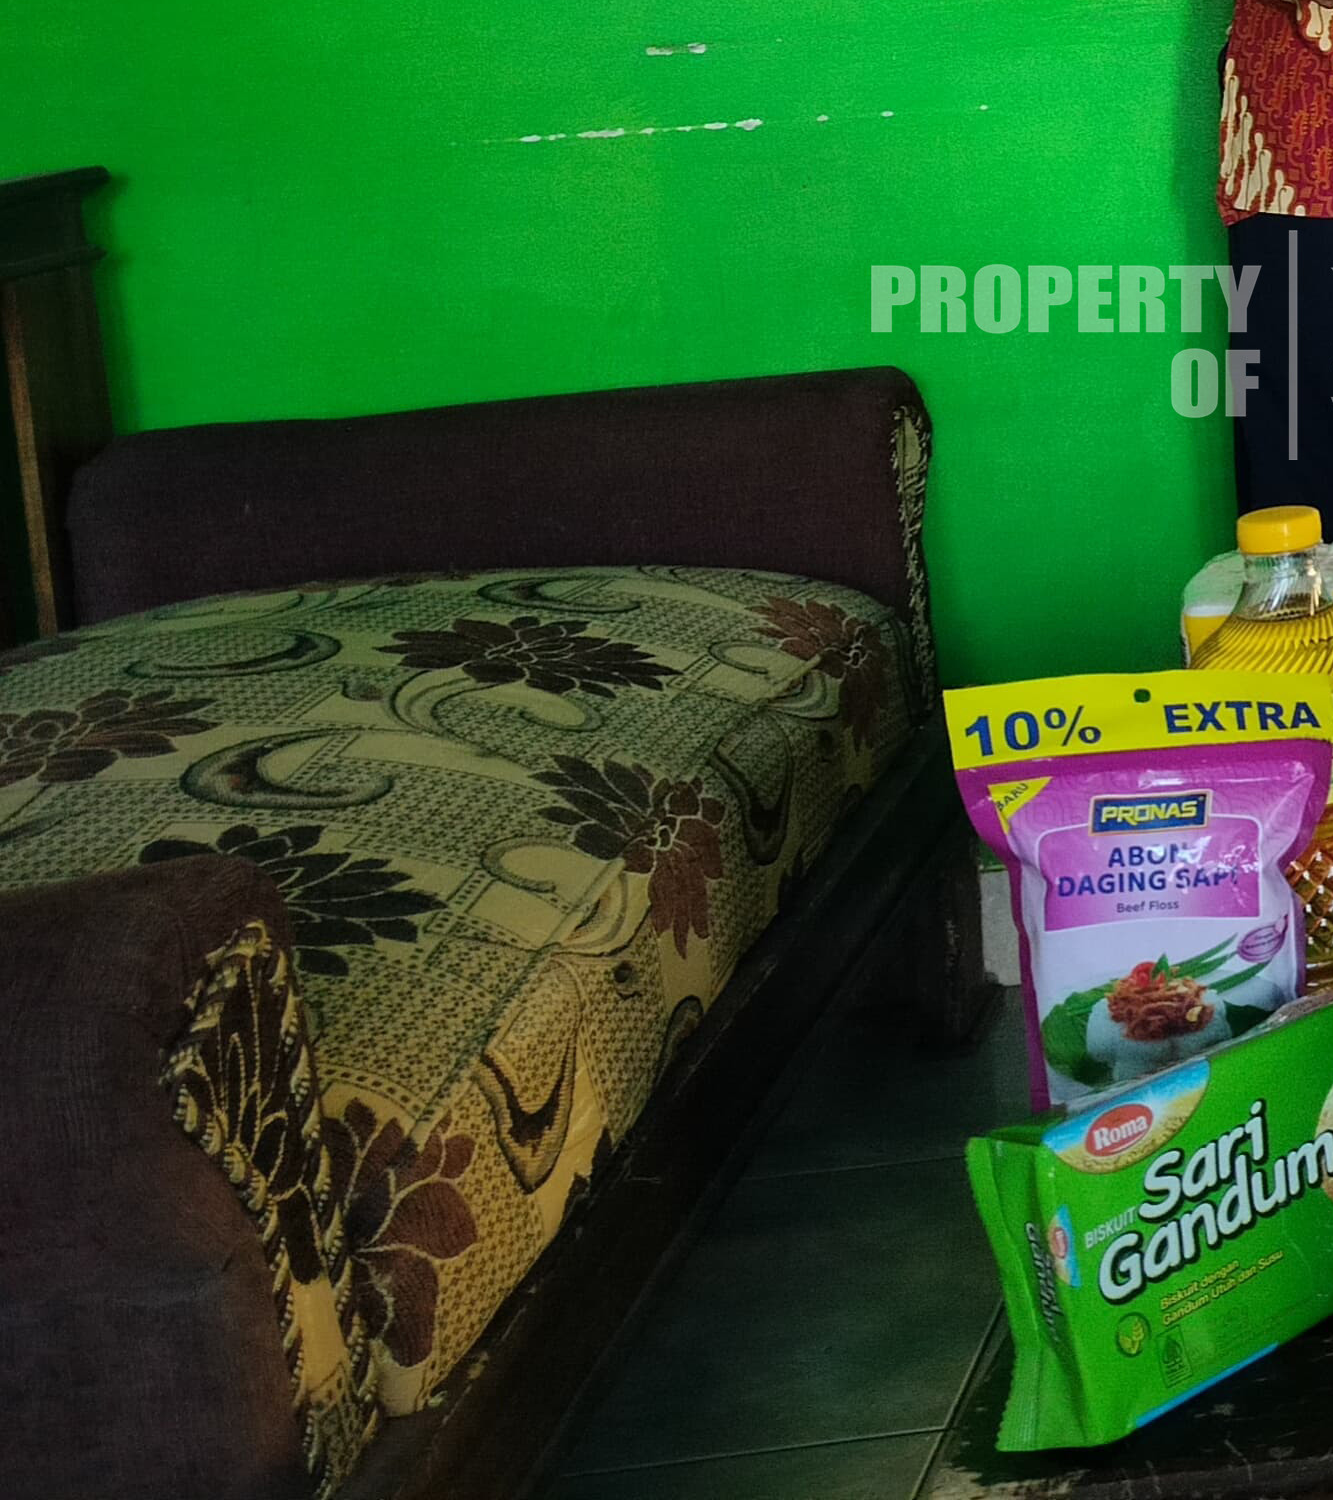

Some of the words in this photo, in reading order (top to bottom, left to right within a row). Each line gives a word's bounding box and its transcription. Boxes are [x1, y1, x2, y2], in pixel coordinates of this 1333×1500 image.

[964, 704, 1102, 758] 10%
[1162, 699, 1322, 736] EXTRA
[1100, 799, 1199, 826] PRONAS
[1107, 842, 1192, 869] ABON
[1057, 869, 1167, 898] DAGING
[1116, 900, 1146, 914] Beef
[1148, 899, 1180, 912] Floss
[1092, 1115, 1149, 1152] Roma
[1138, 1100, 1264, 1219] Sari
[1084, 1205, 1138, 1250] BISKUIT
[1160, 1278, 1200, 1311] Biskuit
[1199, 1259, 1241, 1291] dengan
[1162, 1295, 1210, 1328] Gandum
[1210, 1279, 1237, 1301] Utuh
[1236, 1266, 1259, 1288] dan
[1257, 1249, 1285, 1273] Susu
